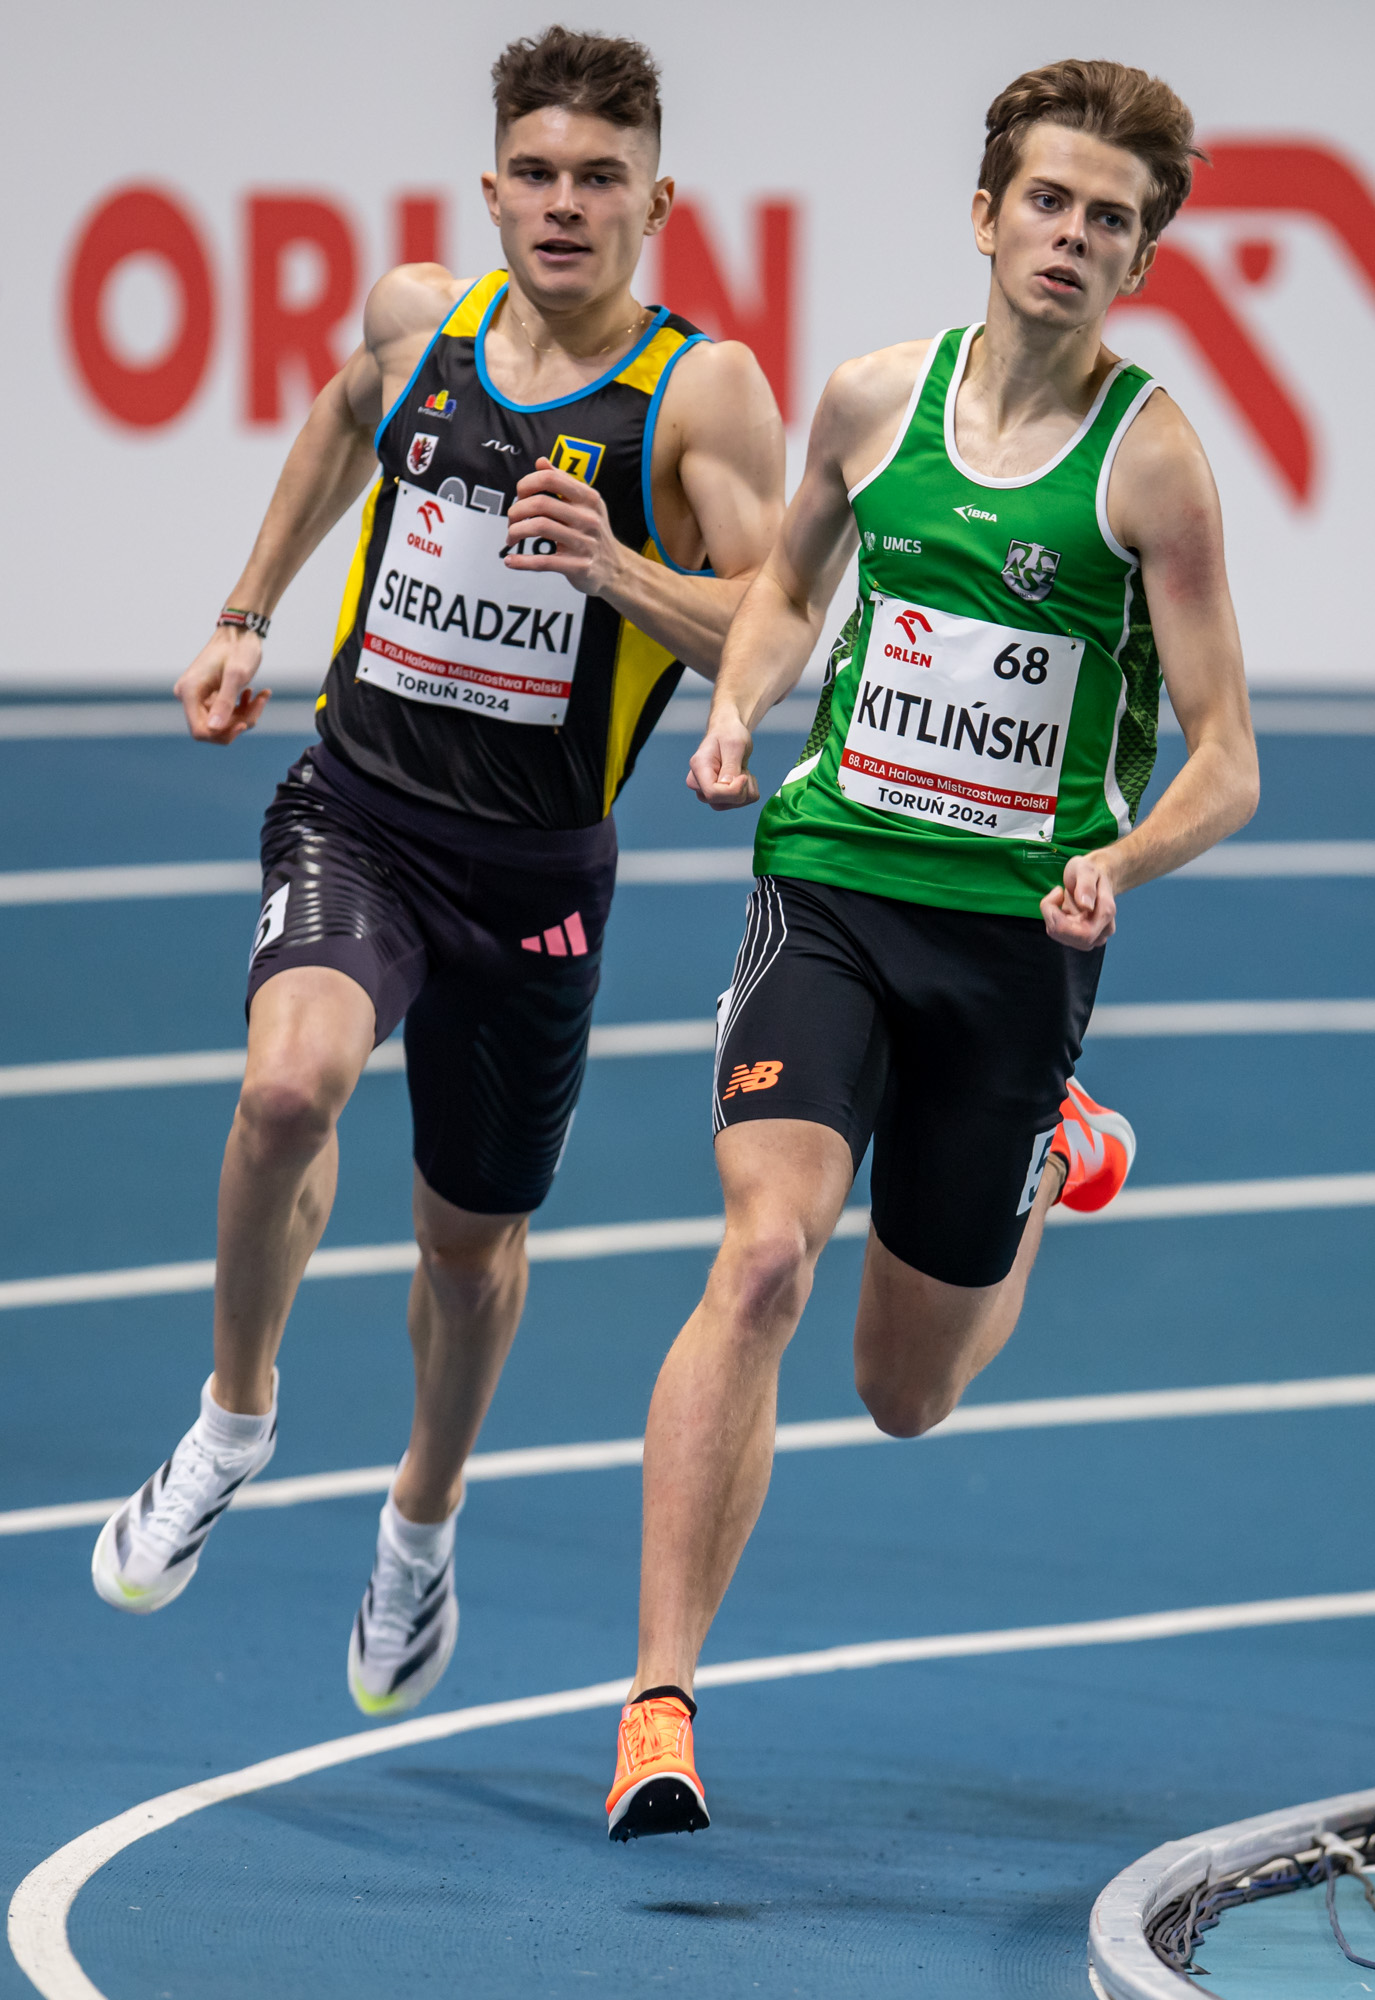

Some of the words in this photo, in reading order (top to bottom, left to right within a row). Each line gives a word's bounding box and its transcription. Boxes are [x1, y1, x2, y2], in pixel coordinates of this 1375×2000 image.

[62, 176, 803, 434] ORN
[407, 532, 443, 558] ORLEN
[883, 535, 922, 554] UMCS
[379, 569, 574, 655] SIERADZKI
[404, 652, 445, 674] Halowe
[448, 665, 523, 690] Mistrzostwa
[525, 680, 563, 696] Polski
[884, 643, 932, 669] ORLEN
[993, 642, 1049, 685] 68
[396, 671, 458, 699] TORUŃ
[462, 688, 510, 712] 2024
[857, 681, 1060, 767] KITLIŃSKI
[848, 753, 861, 768] 68.
[863, 760, 886, 776] PZLA
[888, 765, 934, 787] Halowe
[937, 778, 1012, 805] Mistrzostwa
[1013, 795, 1049, 811] Polski
[878, 787, 945, 816] TORUŃ
[947, 803, 998, 829] 2024
